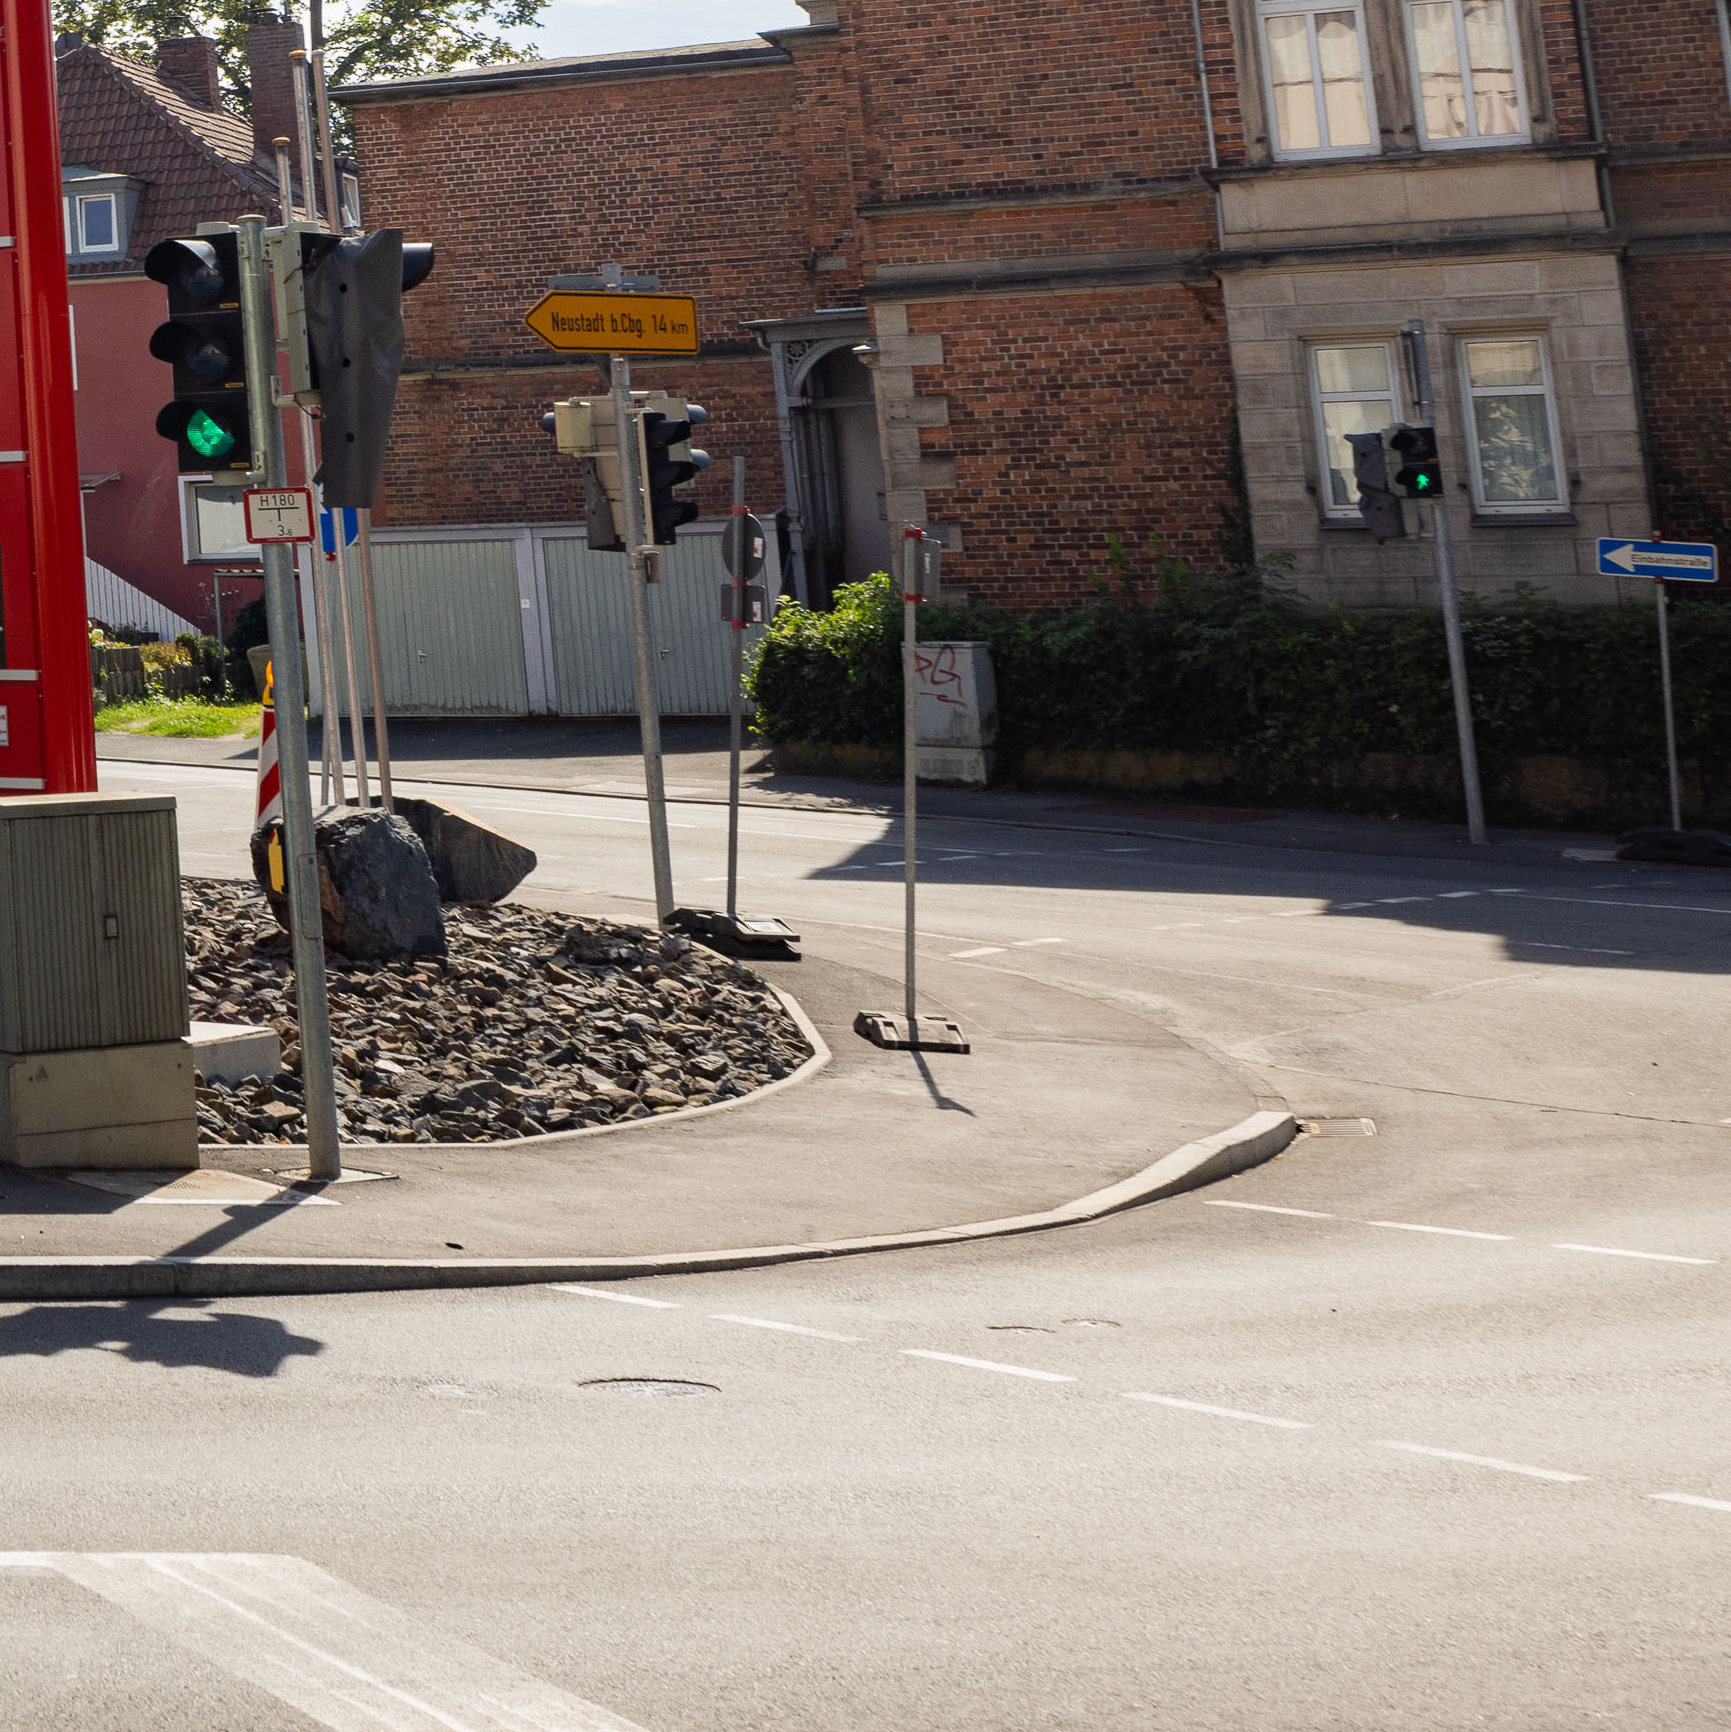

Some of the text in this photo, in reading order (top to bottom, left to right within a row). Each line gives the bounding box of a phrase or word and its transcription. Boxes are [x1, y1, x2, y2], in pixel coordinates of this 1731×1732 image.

[551, 311, 689, 338] Neustadt b.Cbg. 14 km
[1631, 553, 1709, 567] Einbahnstraße
